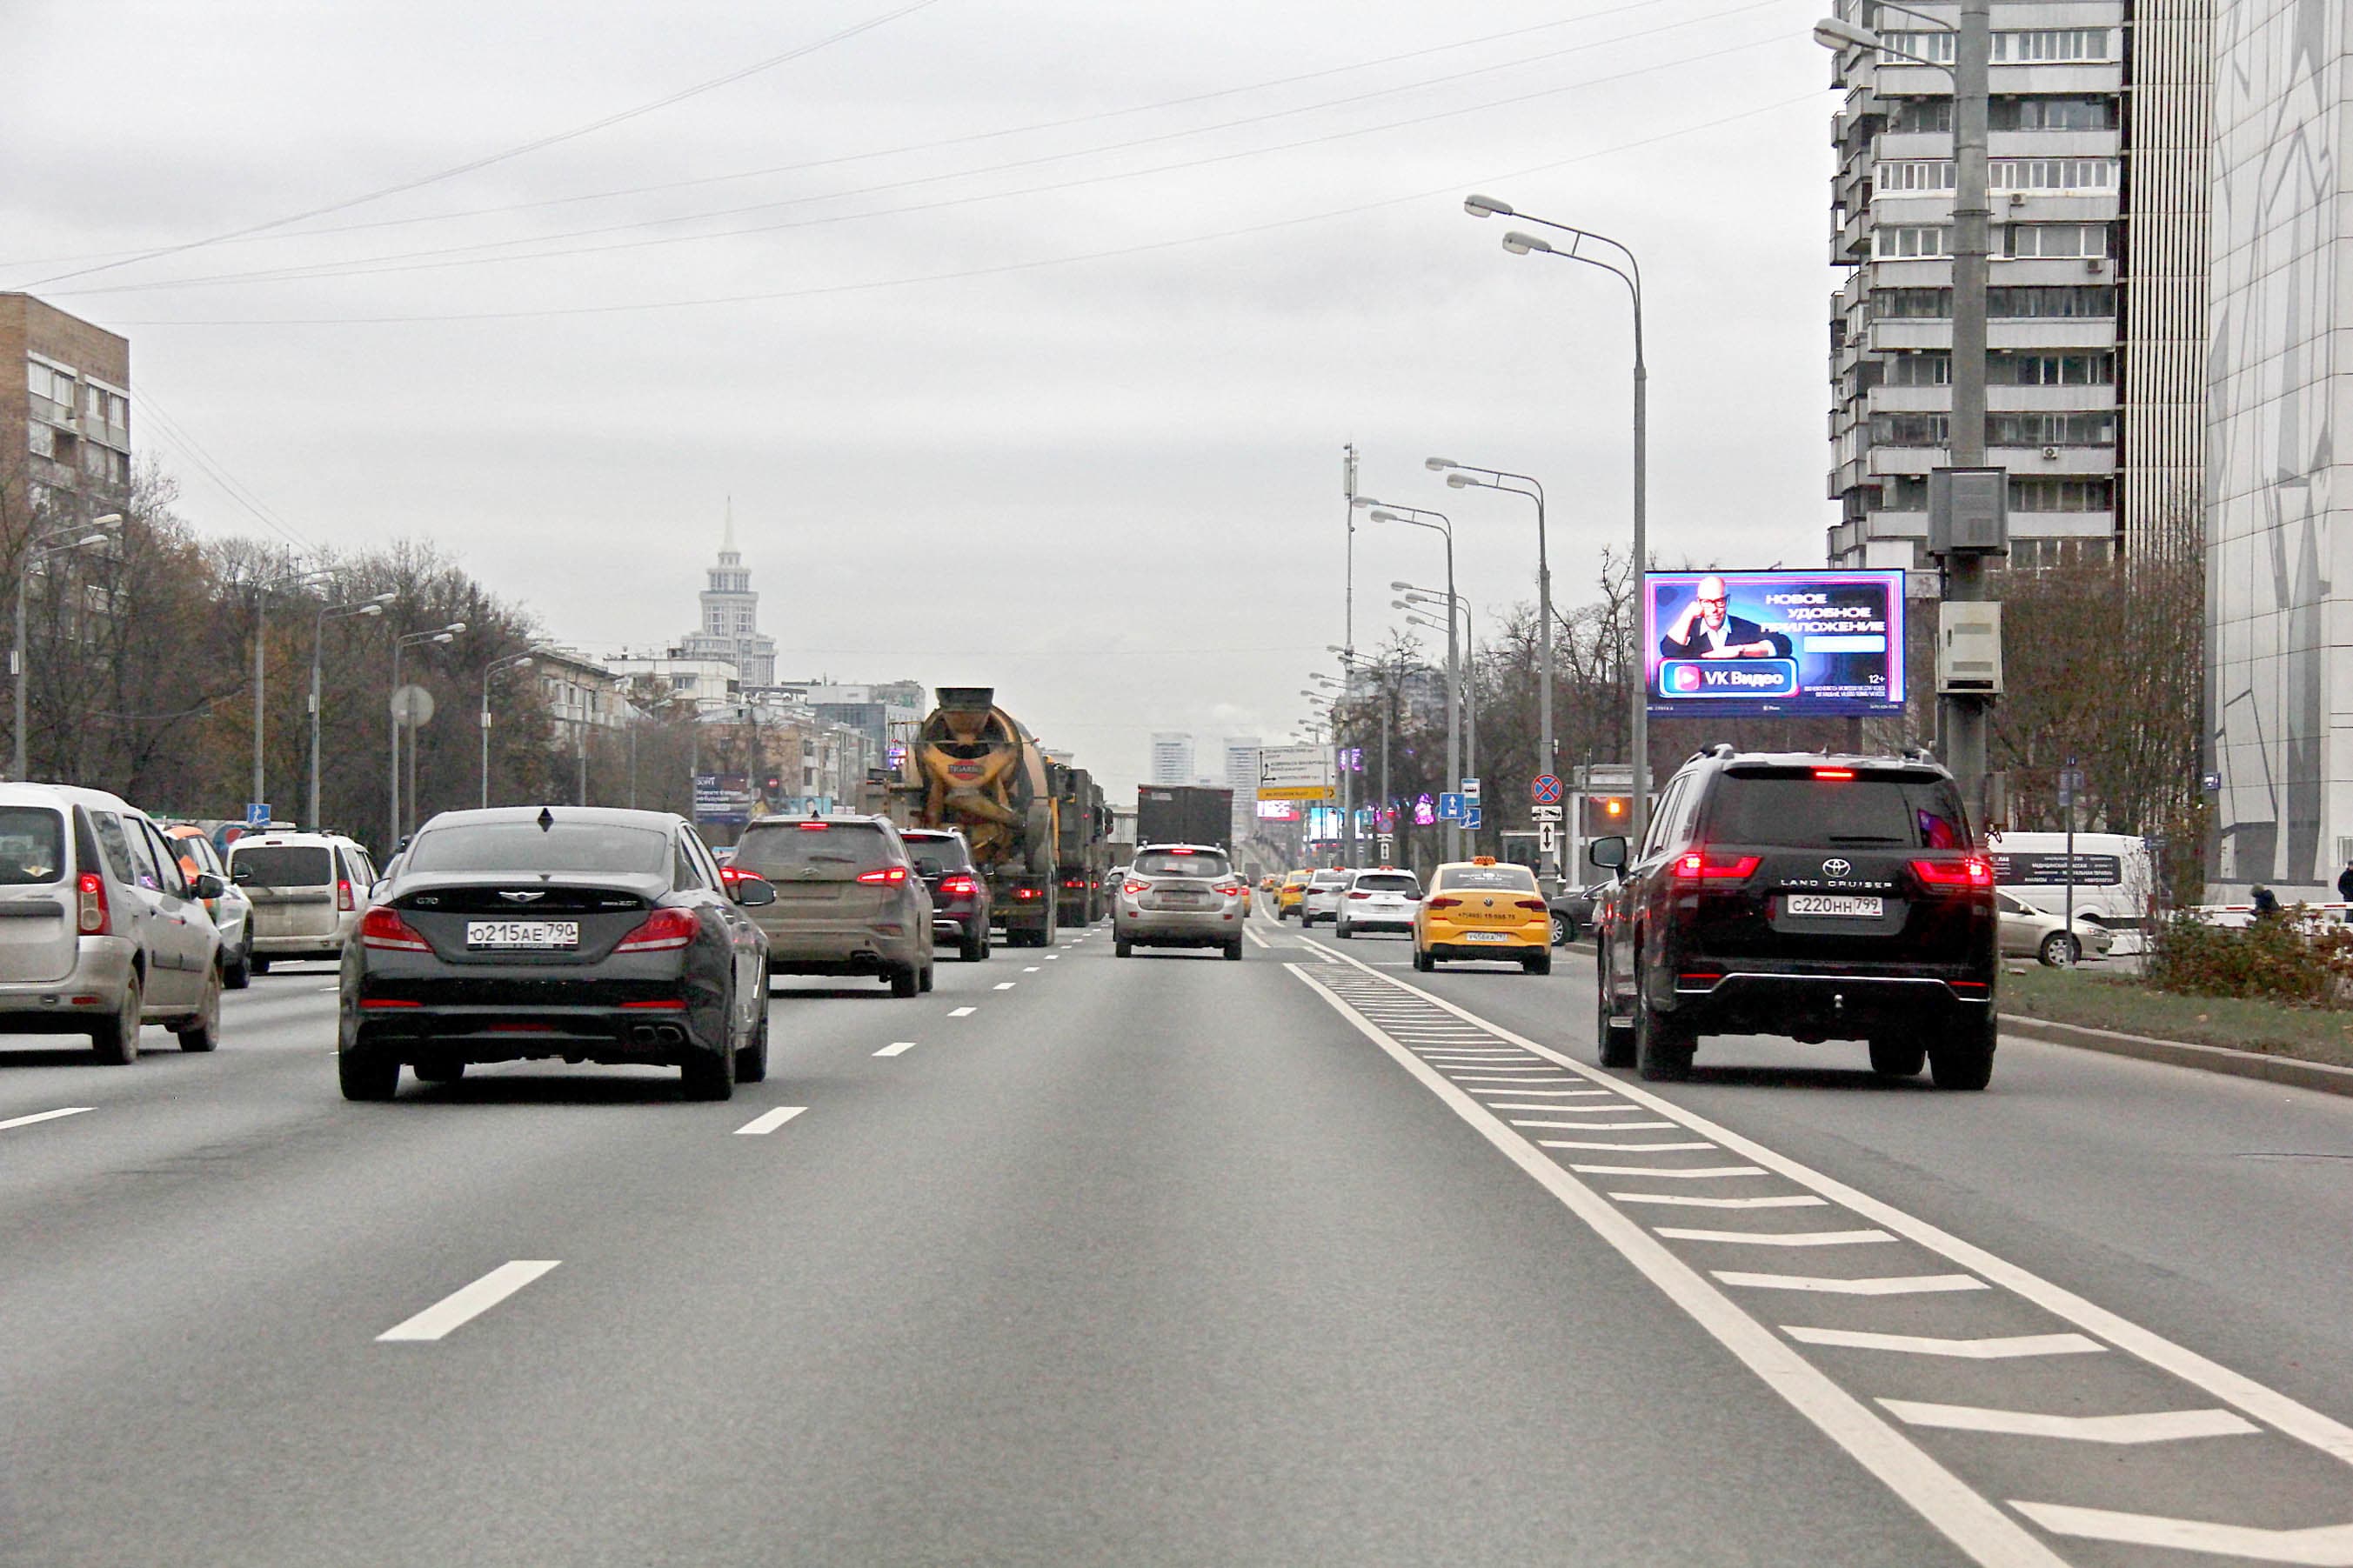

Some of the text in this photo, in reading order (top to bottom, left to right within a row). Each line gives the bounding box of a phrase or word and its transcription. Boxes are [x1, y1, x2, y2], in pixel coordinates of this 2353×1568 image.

[1765, 593, 1828, 605] НОВОЕ
[1788, 607, 1872, 619] УДОБНОЕ
[1760, 621, 1886, 633] ПРИЛОЖЕНИЕ
[1704, 671, 1785, 688] VK Видео
[1868, 674, 1886, 684] 12+
